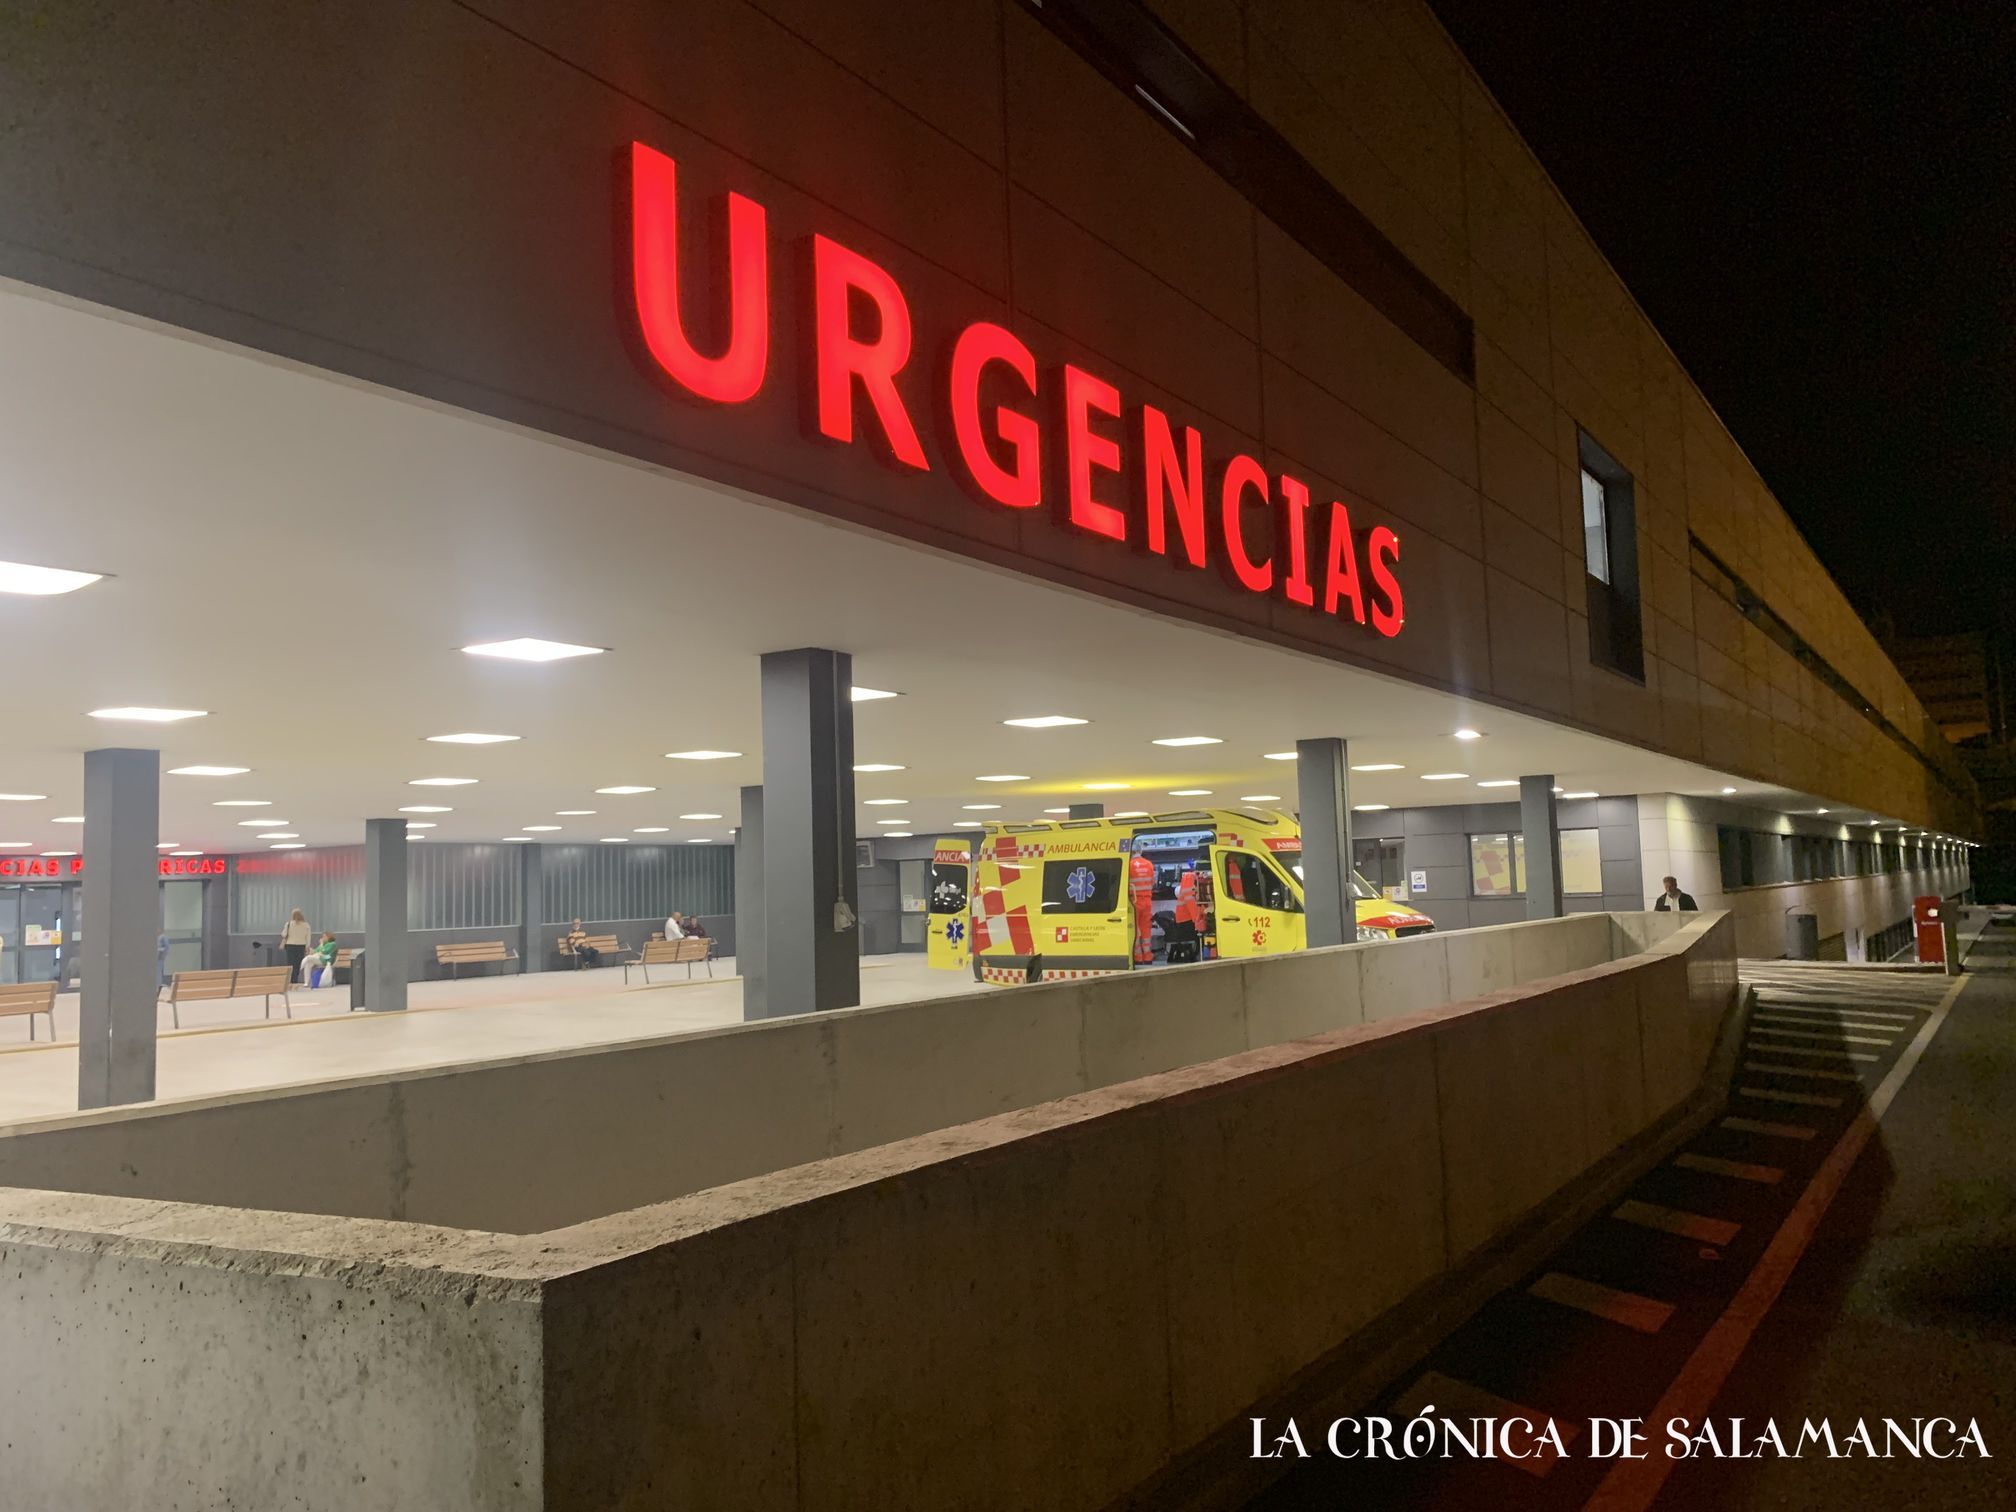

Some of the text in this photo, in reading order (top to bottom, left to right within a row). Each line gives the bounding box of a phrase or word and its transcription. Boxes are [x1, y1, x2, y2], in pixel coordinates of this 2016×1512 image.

[632, 141, 1404, 638] URGENCIAS
[1047, 842, 1116, 854] AMBULANCIA
[1253, 916, 1271, 928] 112
